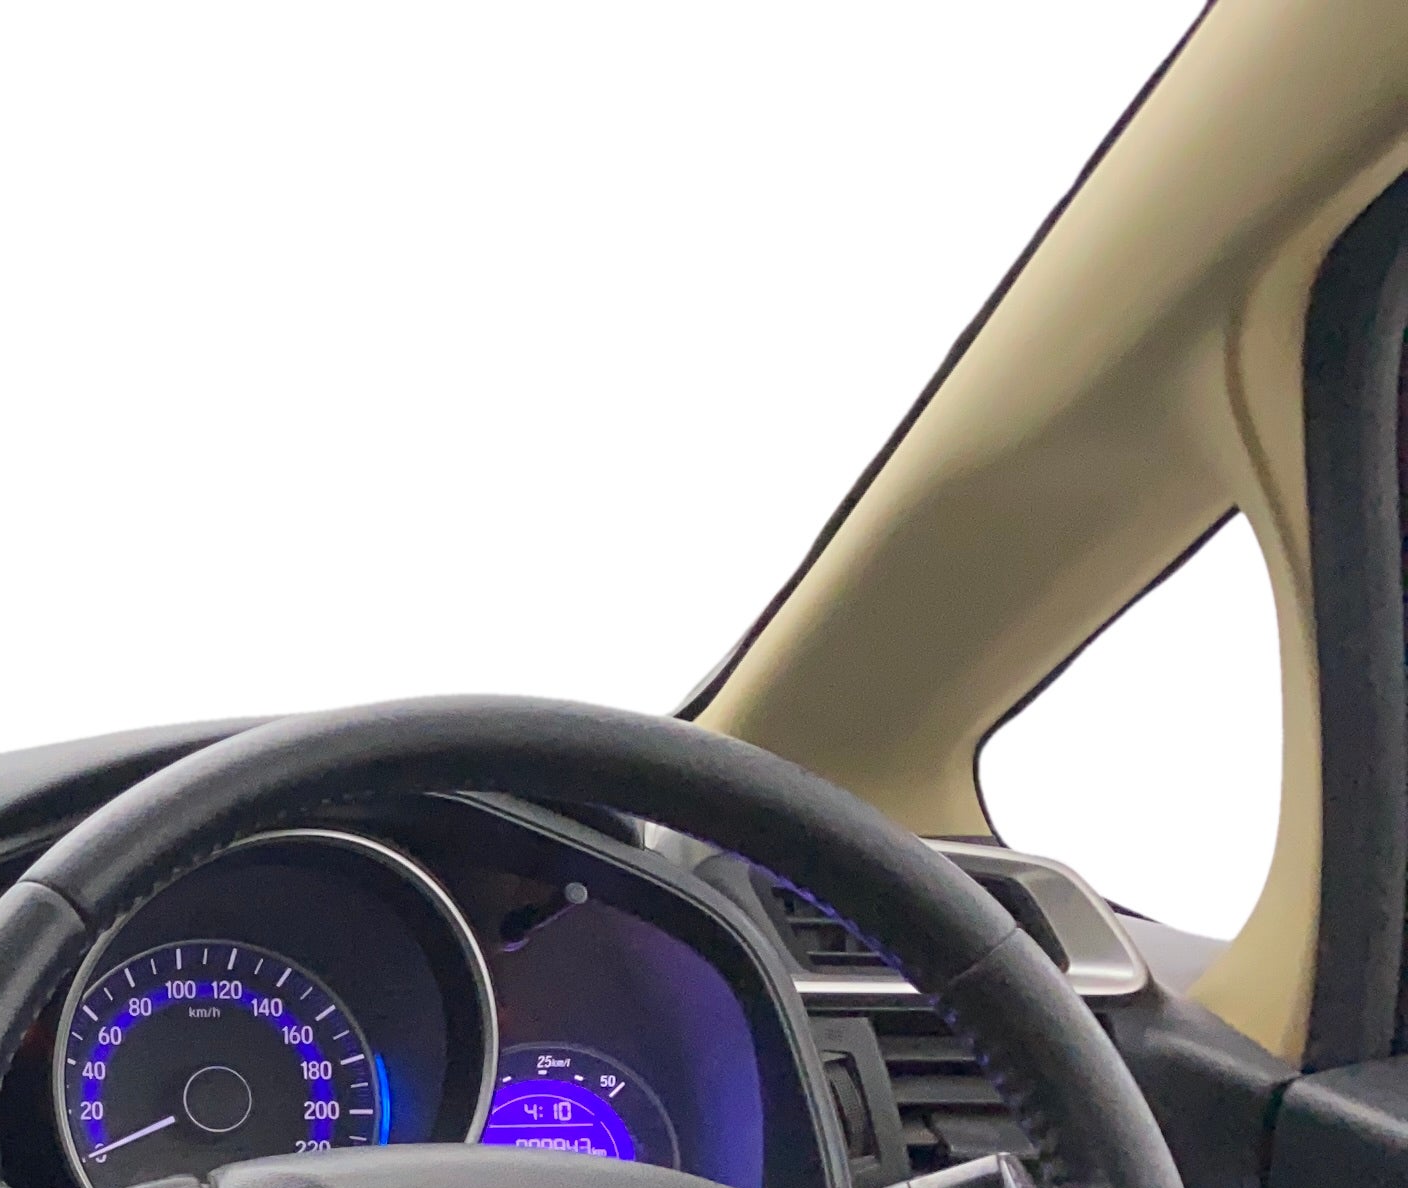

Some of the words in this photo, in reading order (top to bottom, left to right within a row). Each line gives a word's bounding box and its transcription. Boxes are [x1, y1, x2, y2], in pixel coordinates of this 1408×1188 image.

[165, 980, 196, 999] 100
[211, 980, 242, 1000] 120
[128, 997, 152, 1017] 80
[188, 1005, 221, 1019] km/h
[251, 998, 283, 1017] 140
[97, 1025, 122, 1046] 60
[282, 1025, 313, 1045] 160
[82, 1061, 106, 1080] 40
[300, 1060, 332, 1080] 180
[599, 1075, 616, 1088] 50
[80, 1101, 104, 1120] 20
[303, 1101, 340, 1120] 200
